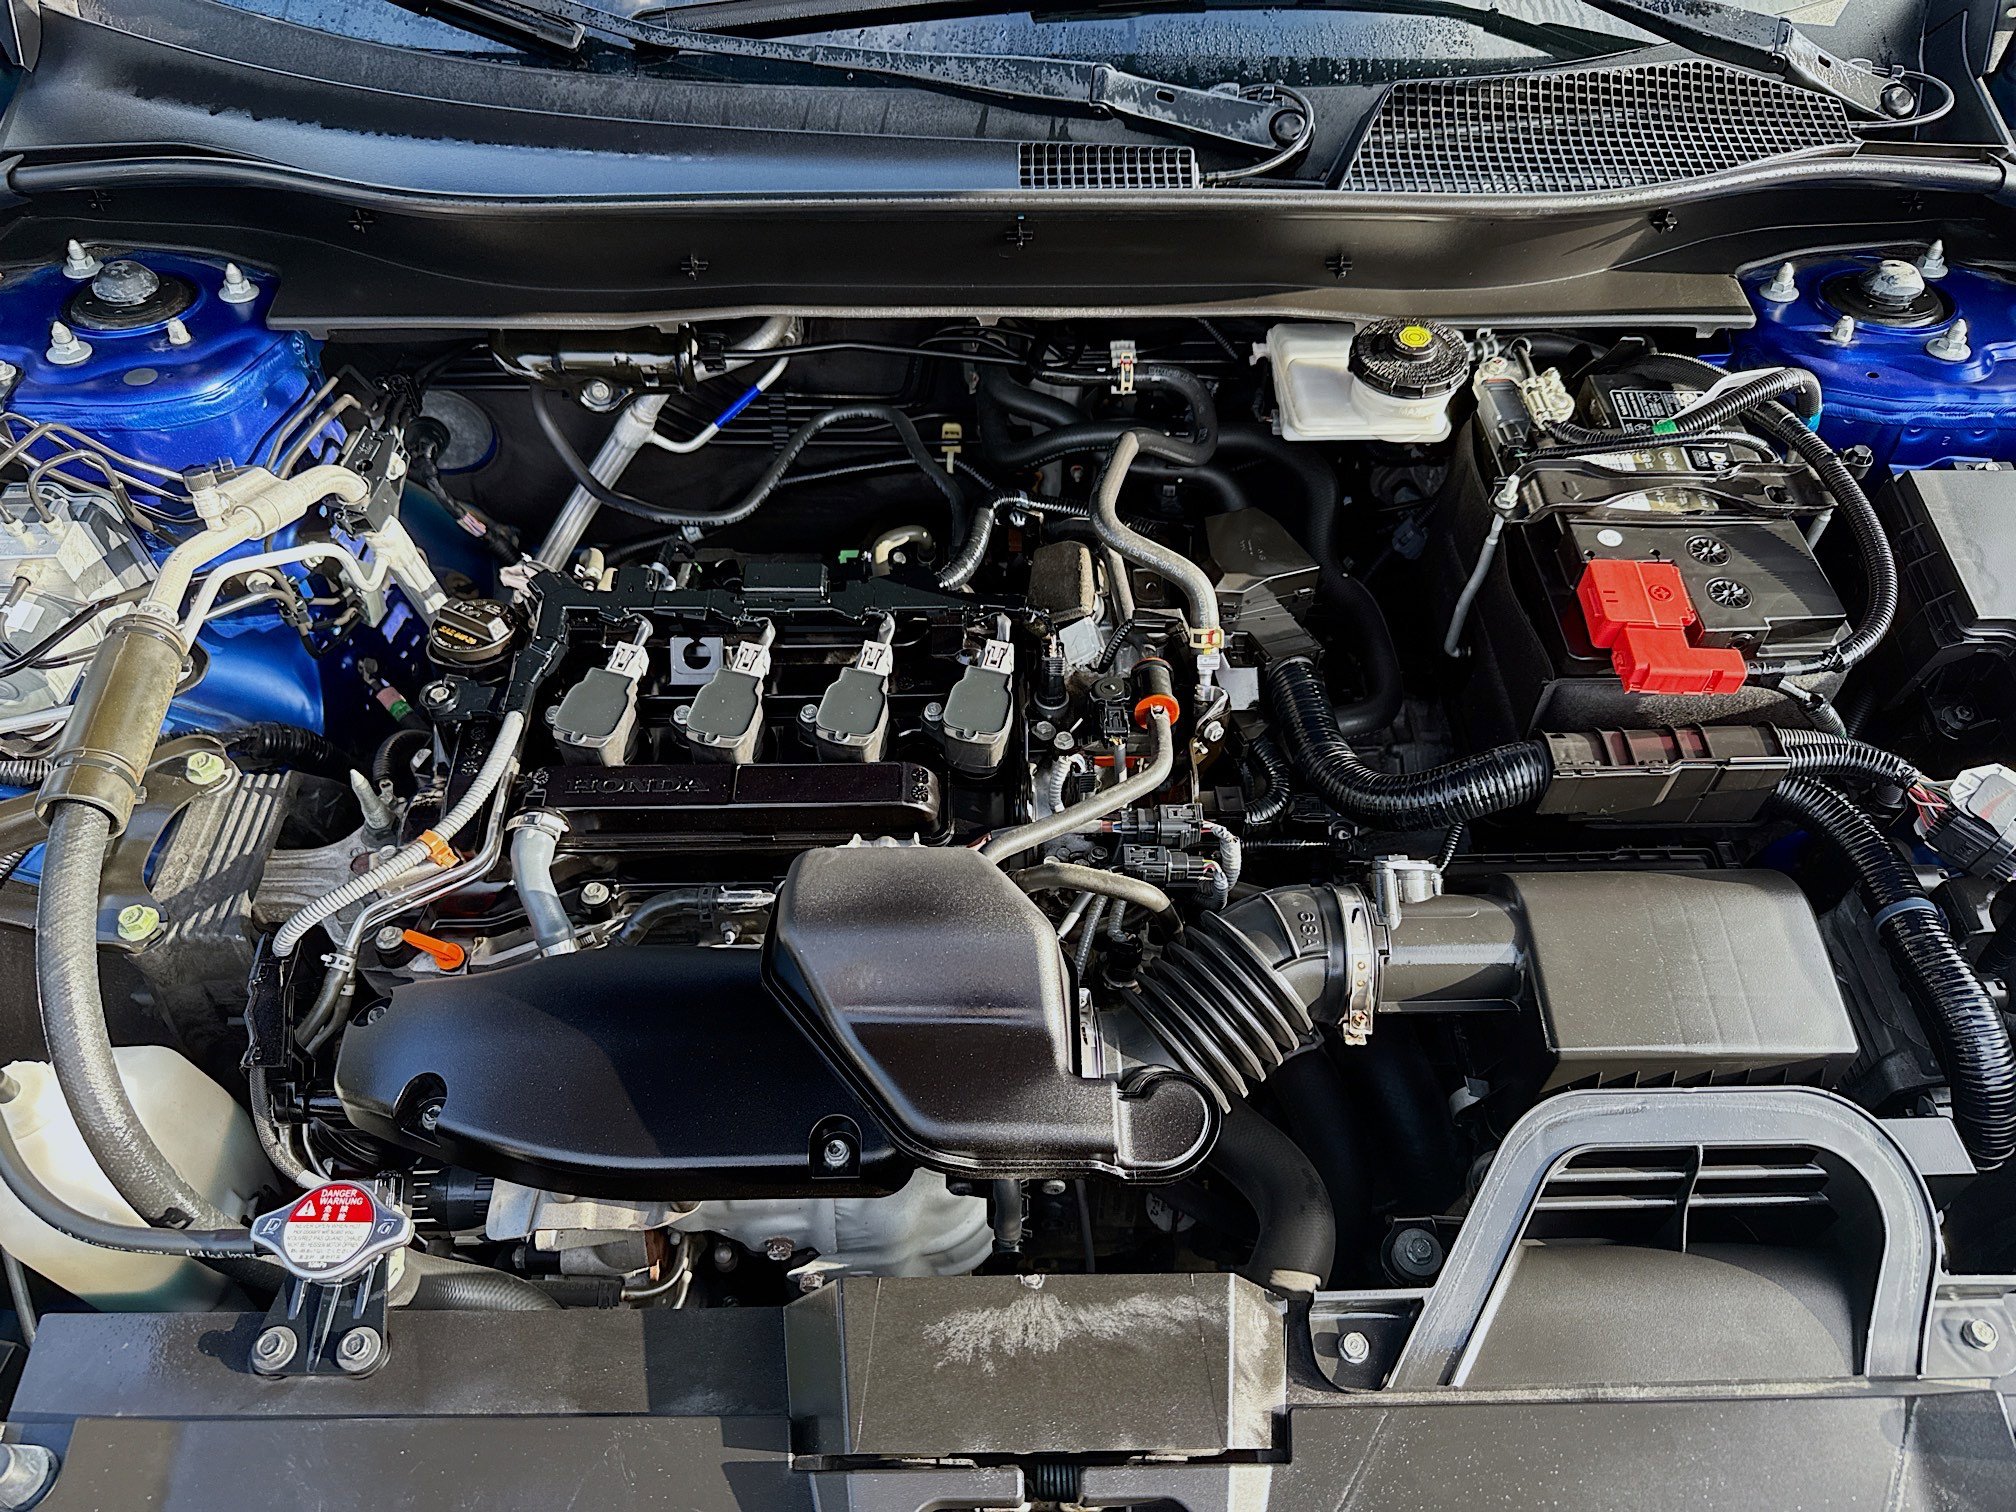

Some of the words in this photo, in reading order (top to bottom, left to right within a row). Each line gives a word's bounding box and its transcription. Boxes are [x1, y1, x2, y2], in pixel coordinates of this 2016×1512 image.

[1400, 407, 1422, 416] MAX
[565, 777, 710, 794] HONDA
[321, 1189, 357, 1197] DANGER
[319, 1197, 363, 1205] WARNUNG
